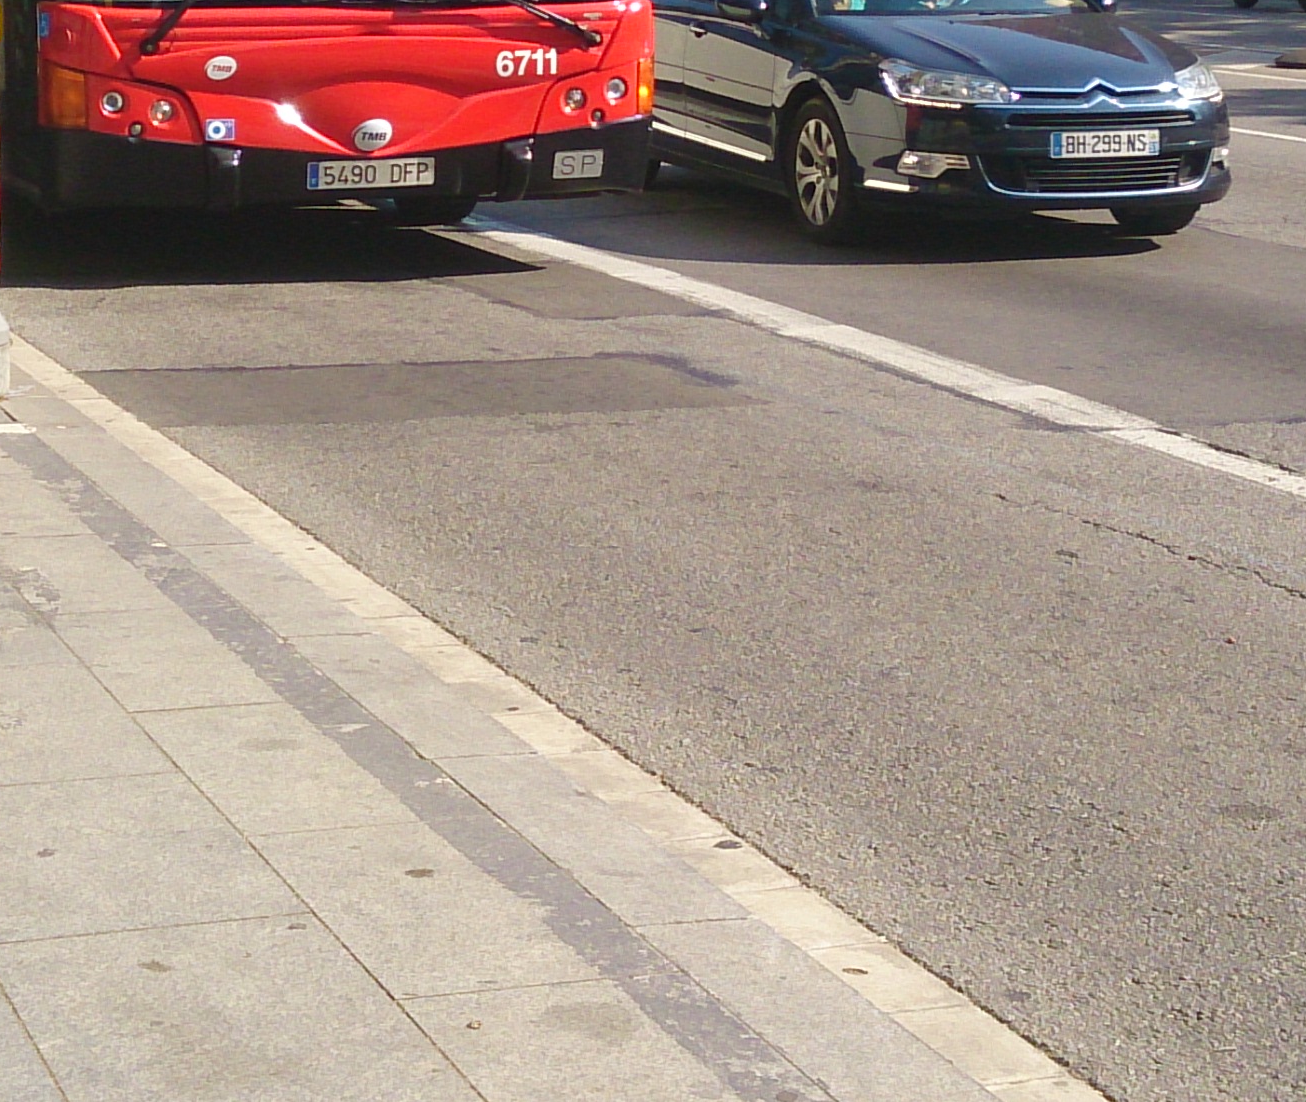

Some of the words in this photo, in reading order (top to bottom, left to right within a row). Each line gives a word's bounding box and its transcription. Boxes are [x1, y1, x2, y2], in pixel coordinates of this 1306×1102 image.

[211, 63, 233, 74] TMB
[496, 48, 558, 77] 6711
[361, 131, 387, 142] TMB
[323, 164, 377, 186] 5490
[390, 162, 430, 183] DFP
